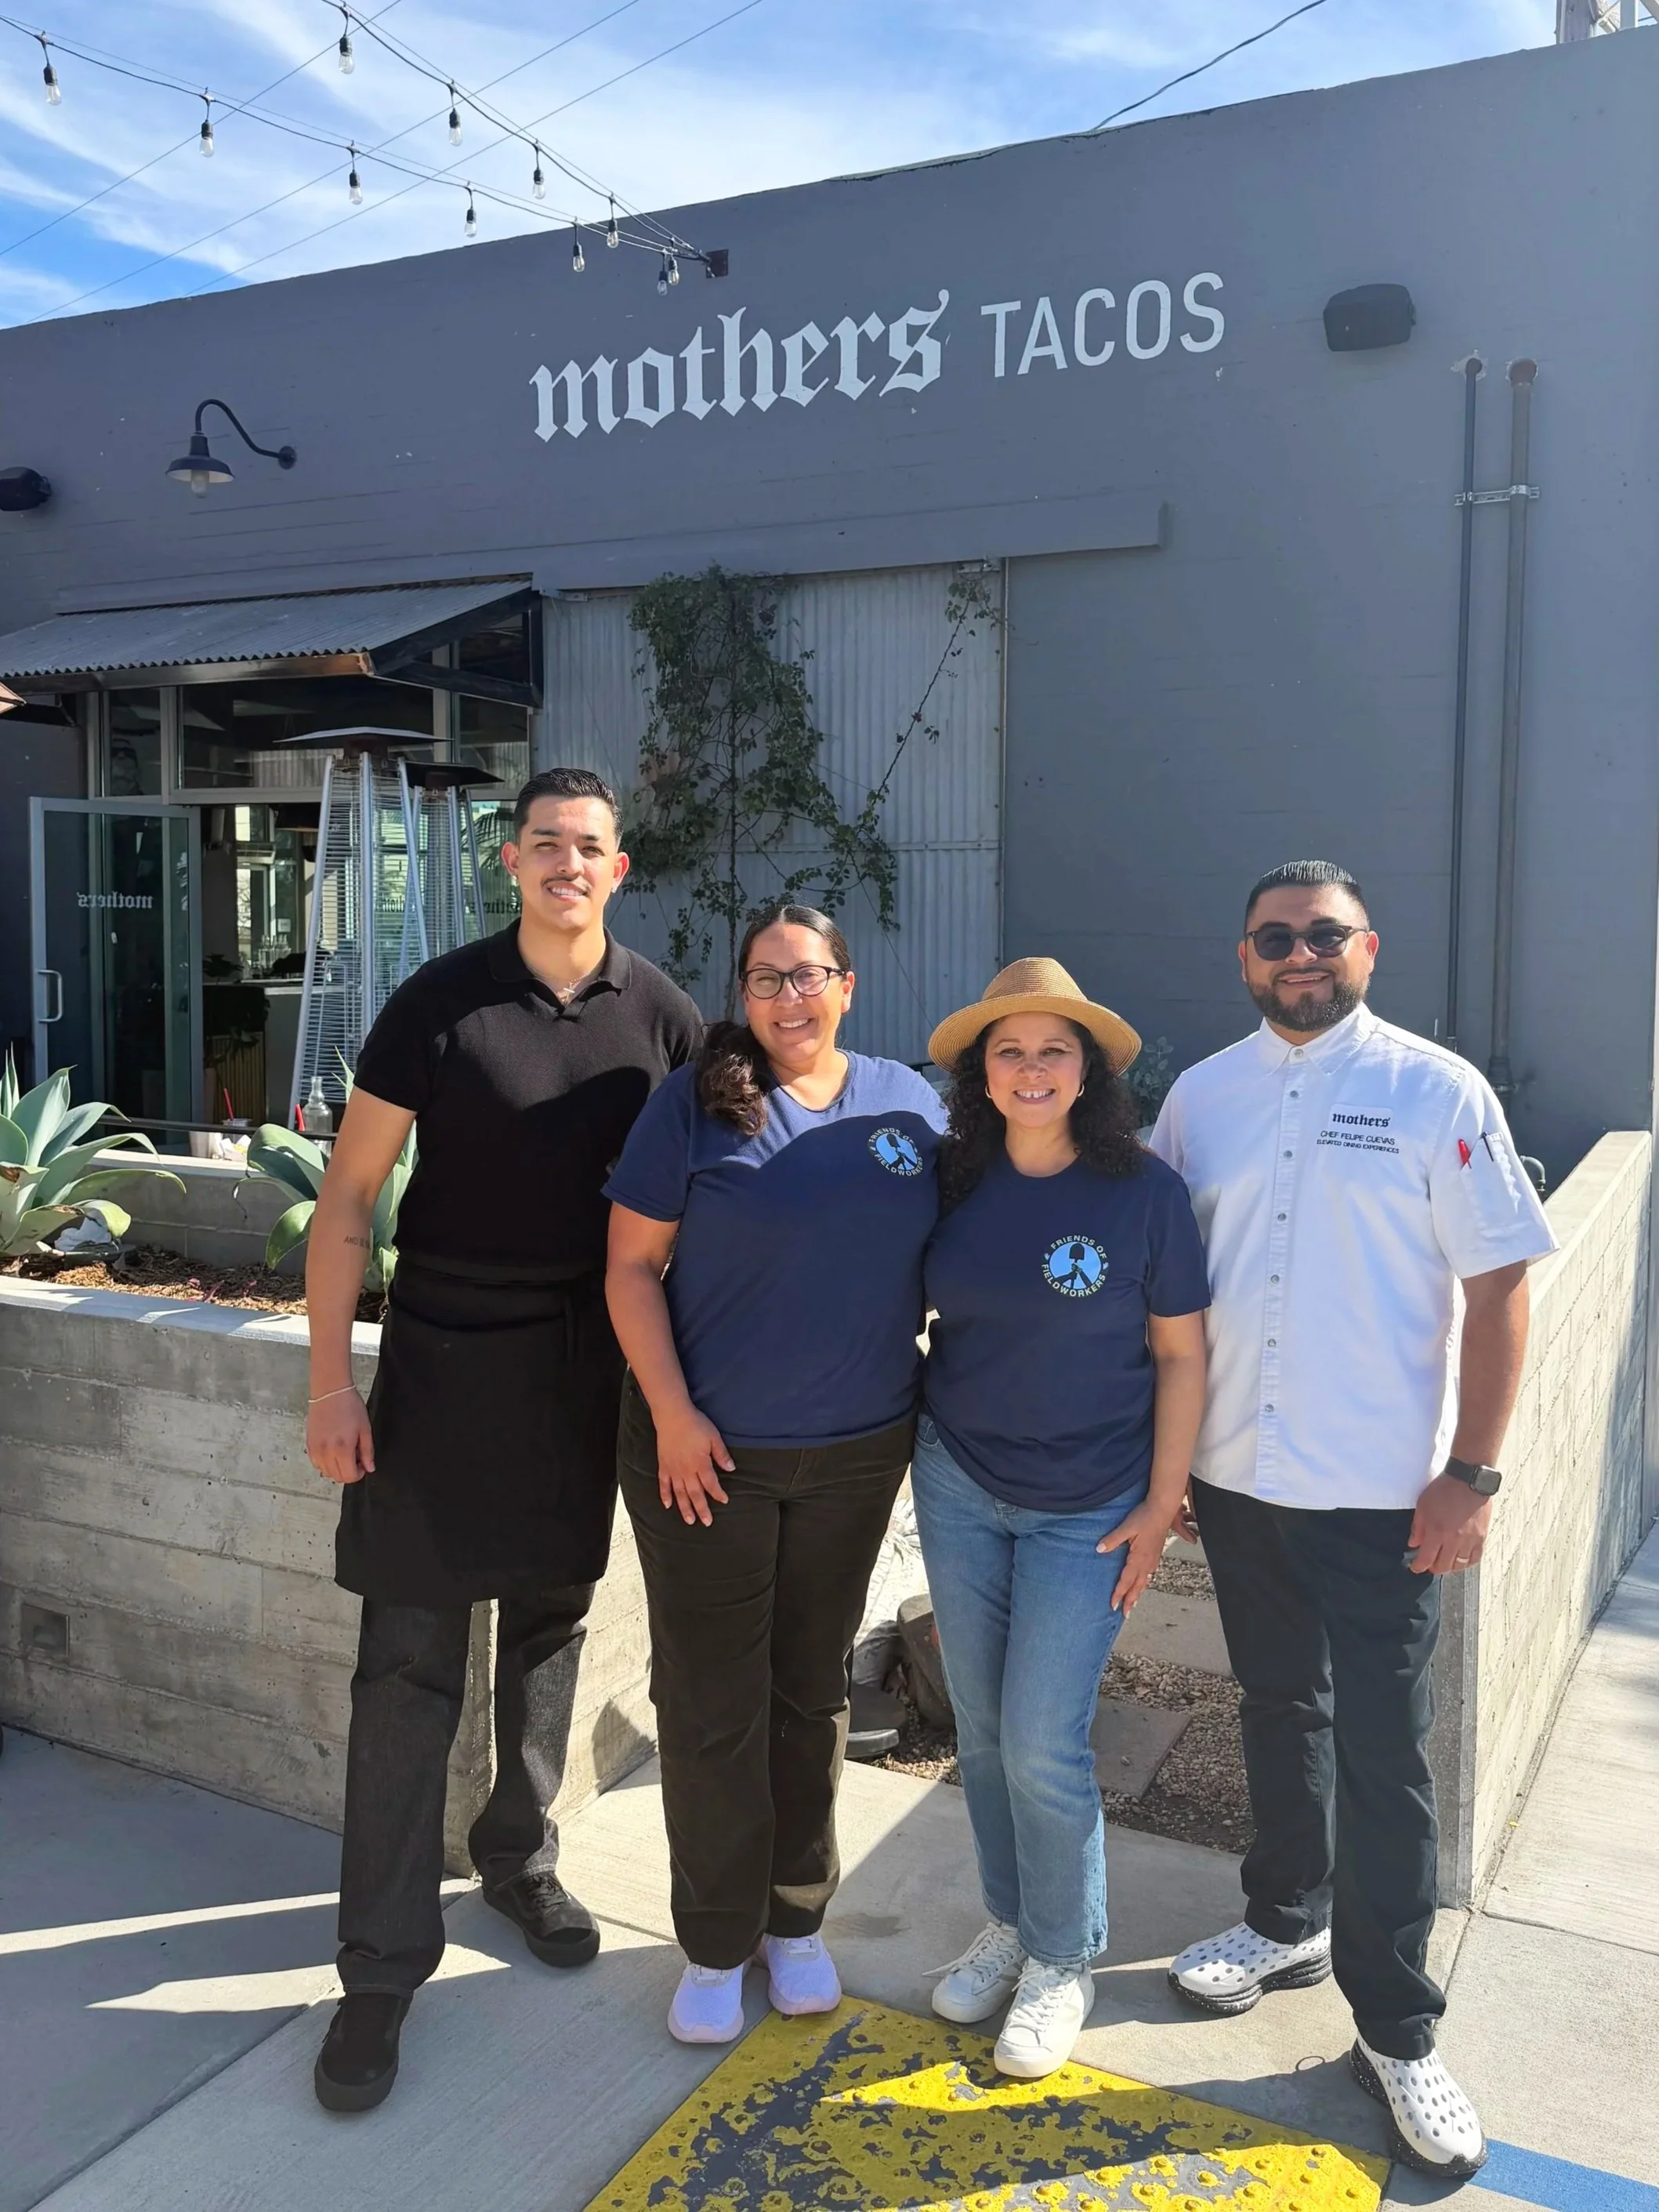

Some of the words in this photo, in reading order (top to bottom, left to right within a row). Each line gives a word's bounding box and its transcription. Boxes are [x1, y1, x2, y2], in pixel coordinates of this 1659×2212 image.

[529, 288, 950, 443] mothers
[980, 271, 1226, 379] TACOS
[1332, 1113, 1391, 1127] mothers
[868, 1127, 900, 1143] FRIENDS
[1341, 1133, 1364, 1141] FELIPE
[1366, 1135, 1396, 1145] CUEVAS
[1362, 1144, 1400, 1154] EXPERIENCES
[875, 1154, 923, 1177] FIELDWORKERS
[1050, 1235, 1096, 1250] FRIENDS
[1096, 1245, 1107, 1259] OF
[1041, 1264, 1106, 1297] FIELDWORKERS
